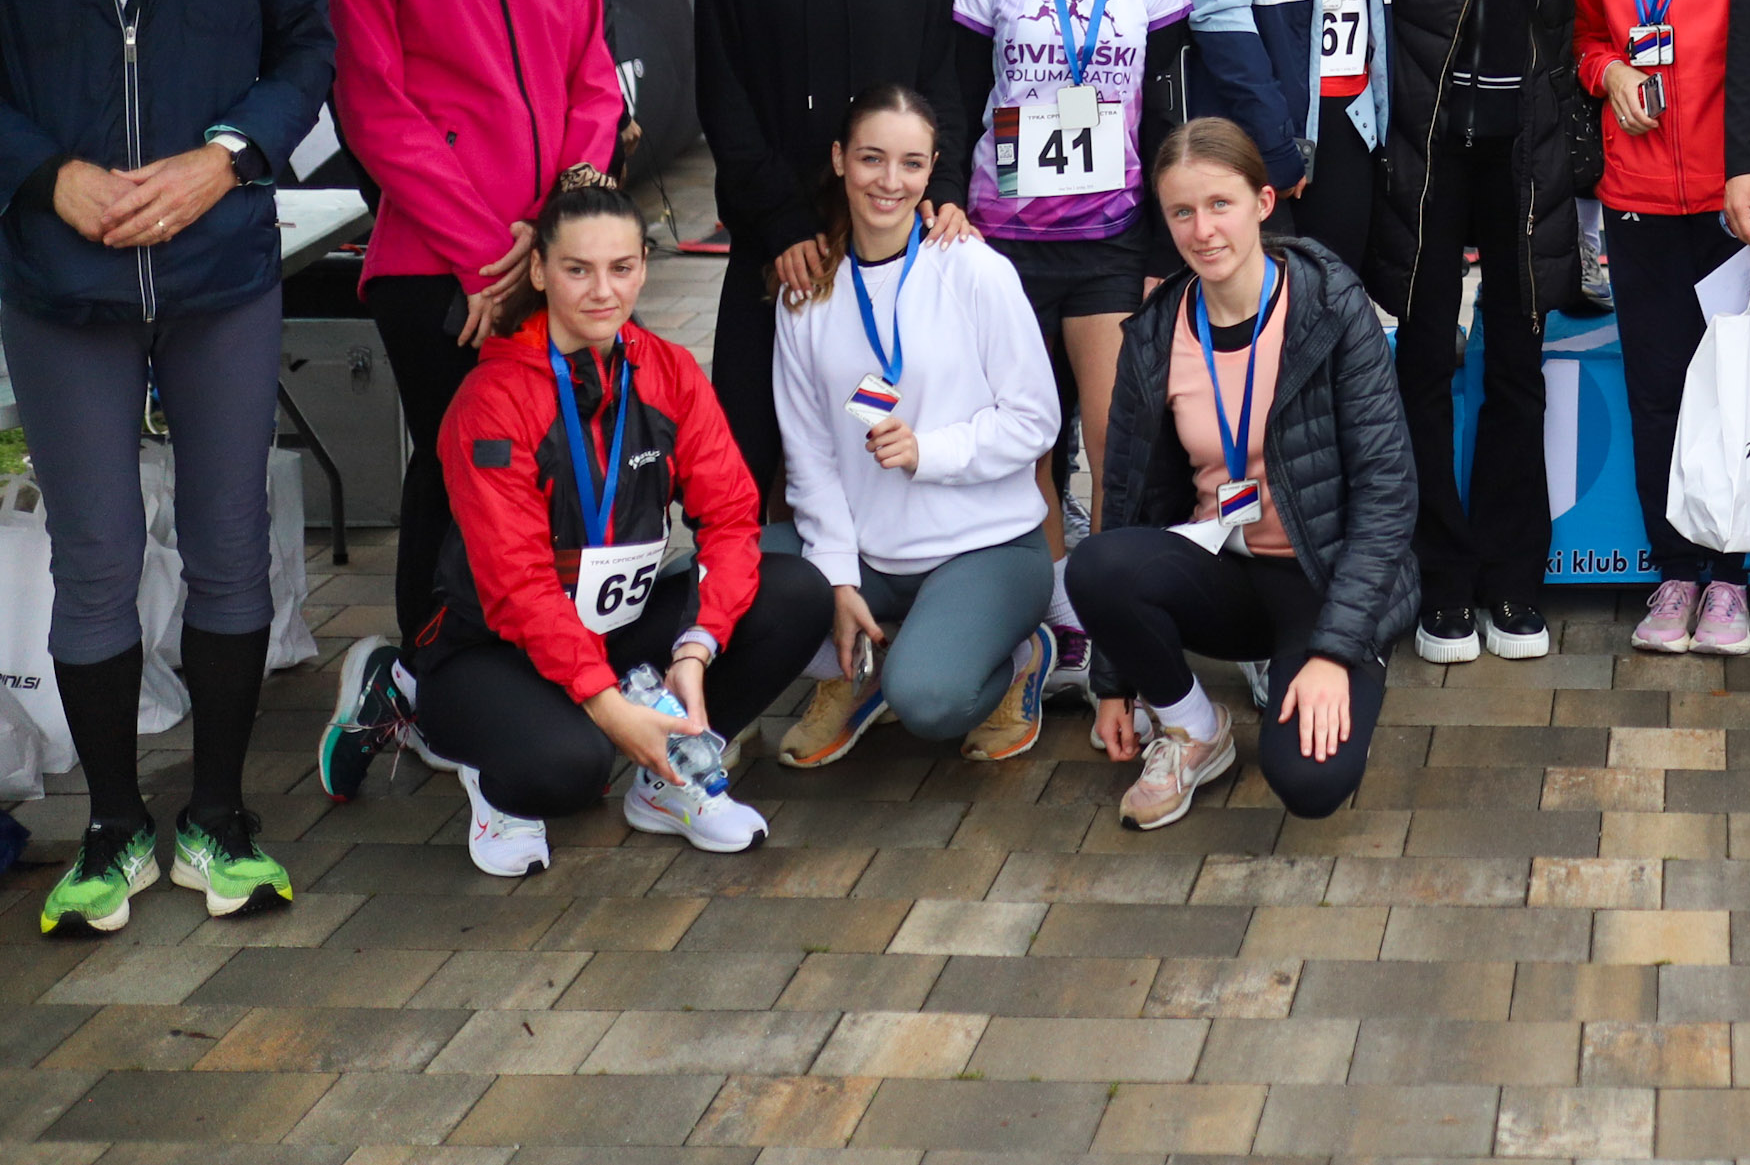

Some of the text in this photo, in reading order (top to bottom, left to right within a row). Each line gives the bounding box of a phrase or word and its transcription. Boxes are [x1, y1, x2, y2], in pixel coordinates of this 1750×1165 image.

[1321, 11, 1361, 57] 67
[1037, 126, 1094, 175] 41
[1572, 549, 1628, 574] klub
[595, 561, 658, 617] 65
